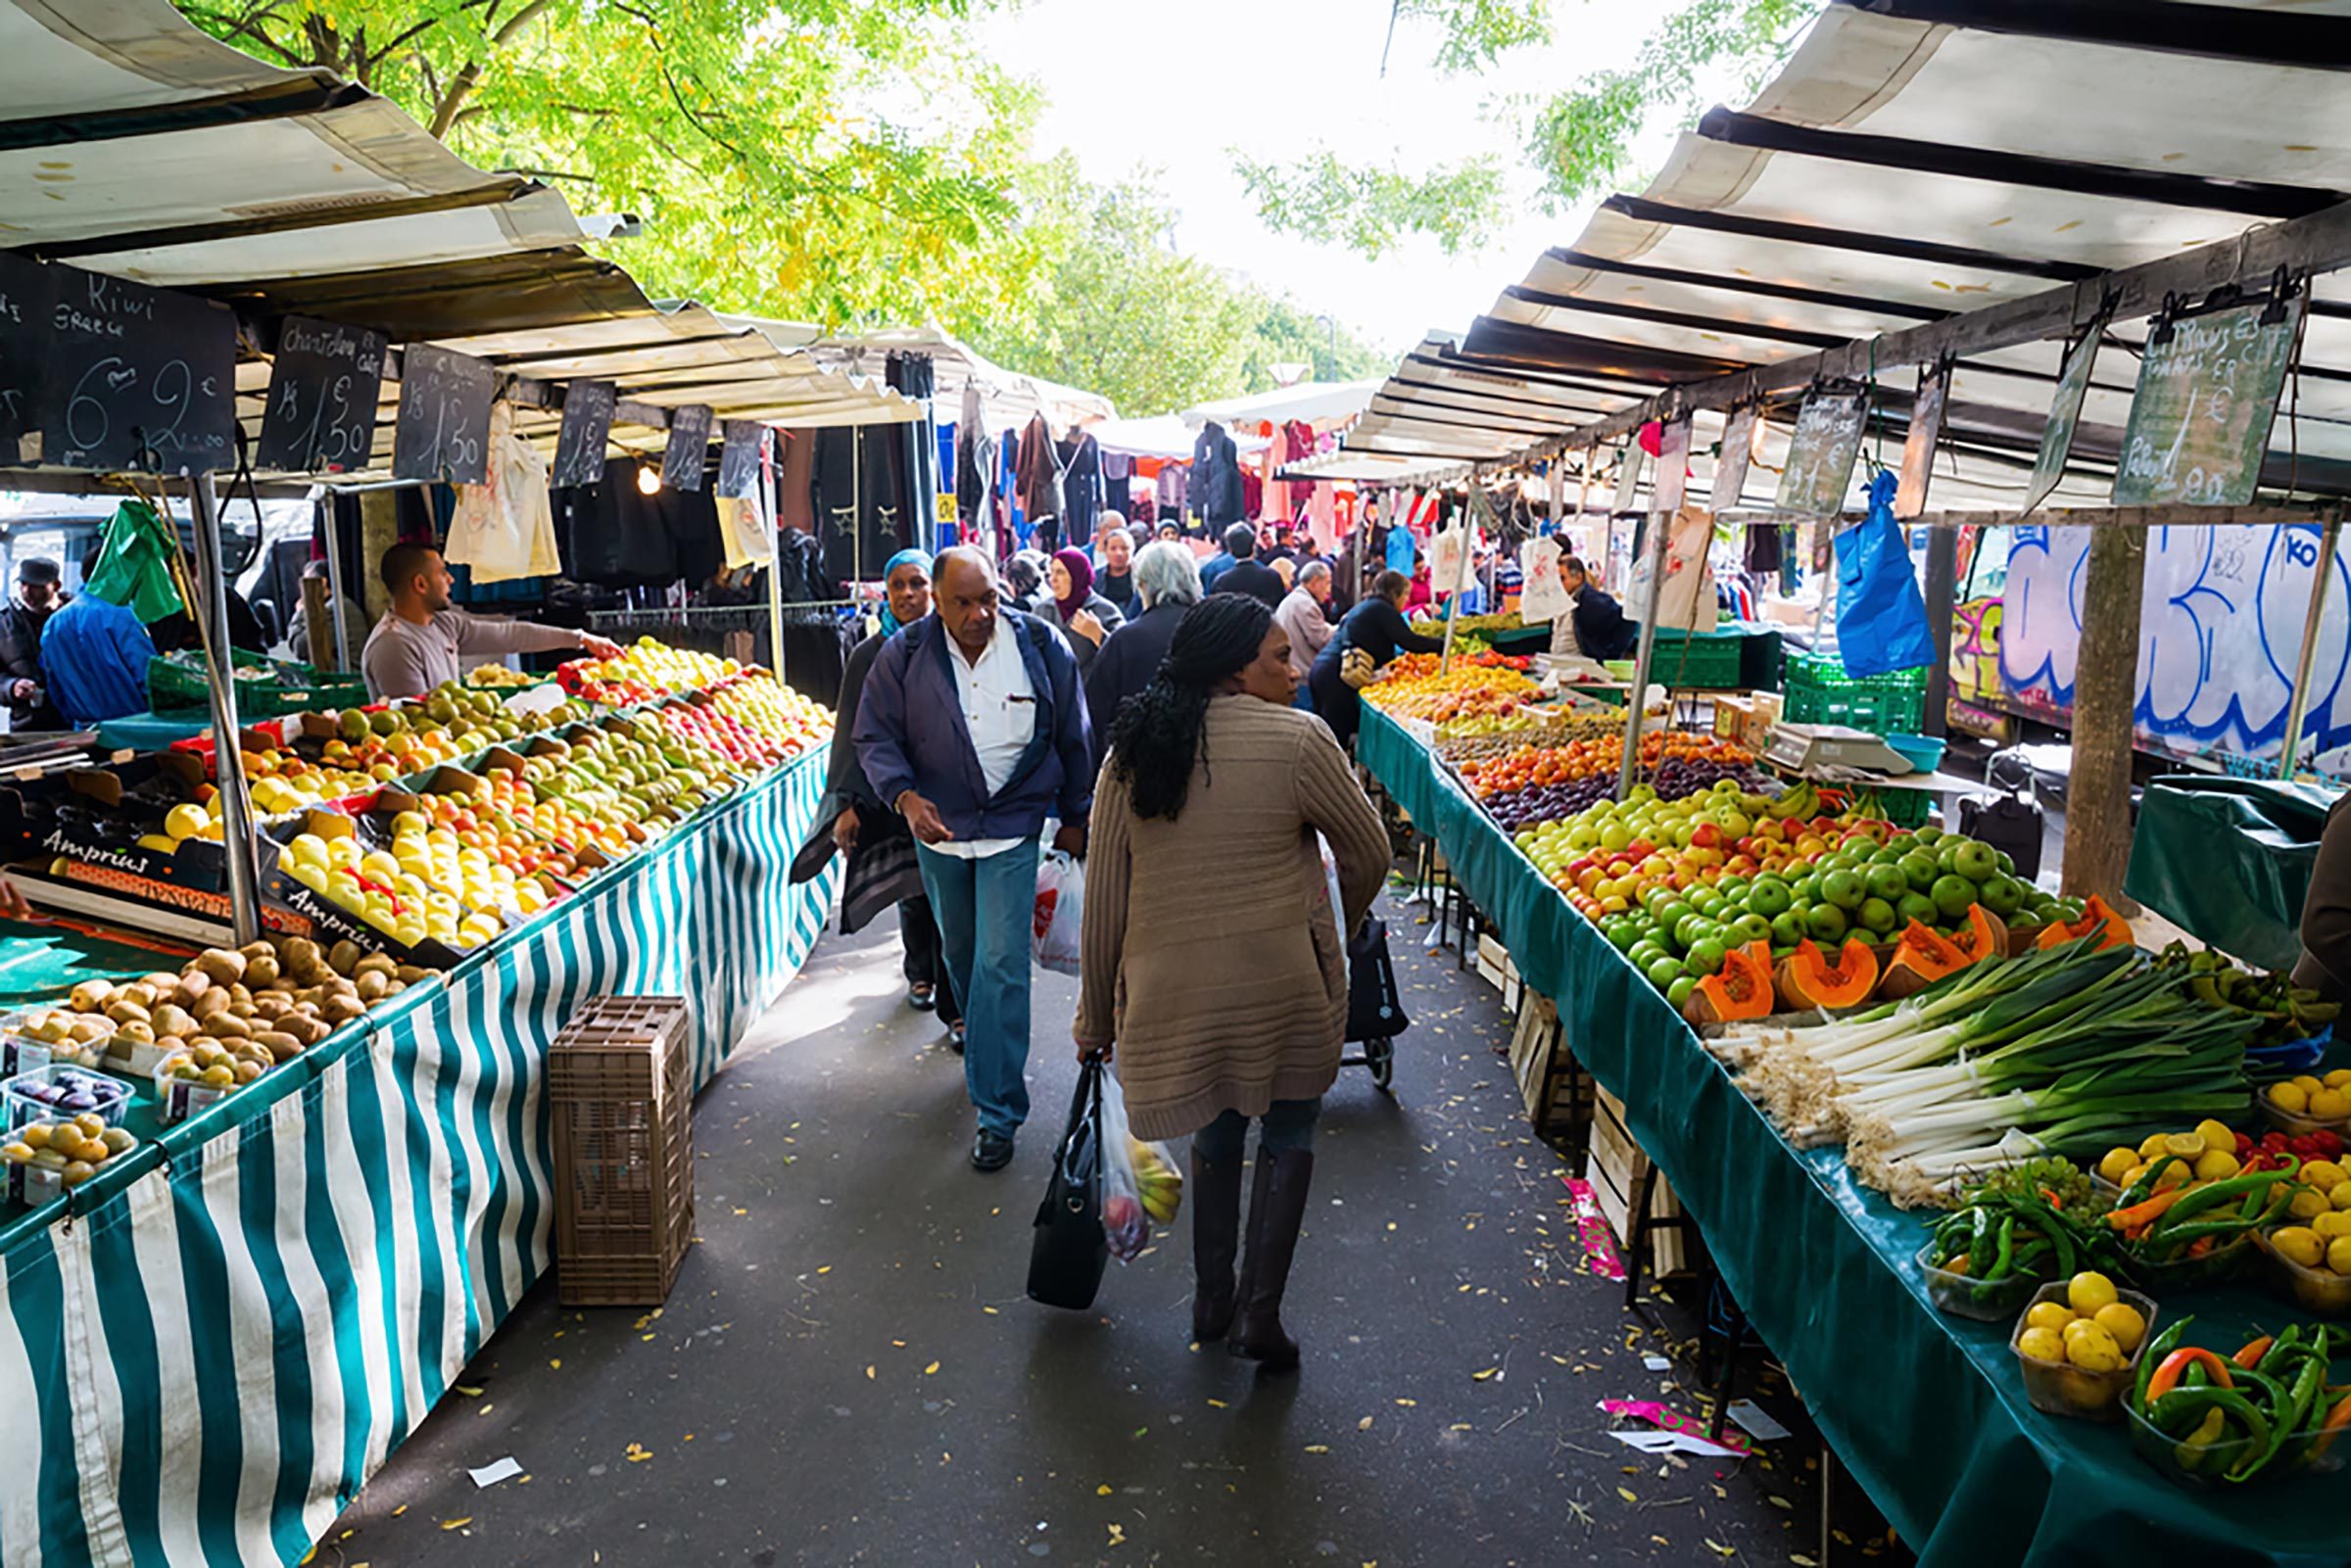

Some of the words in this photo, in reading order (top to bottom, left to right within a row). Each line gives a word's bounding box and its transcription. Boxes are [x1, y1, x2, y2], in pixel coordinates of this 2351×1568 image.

[88, 273, 155, 320] Kiwi
[67, 356, 122, 450] 6
[2286, 534, 2318, 568] KO
[42, 829, 149, 874] Amprius
